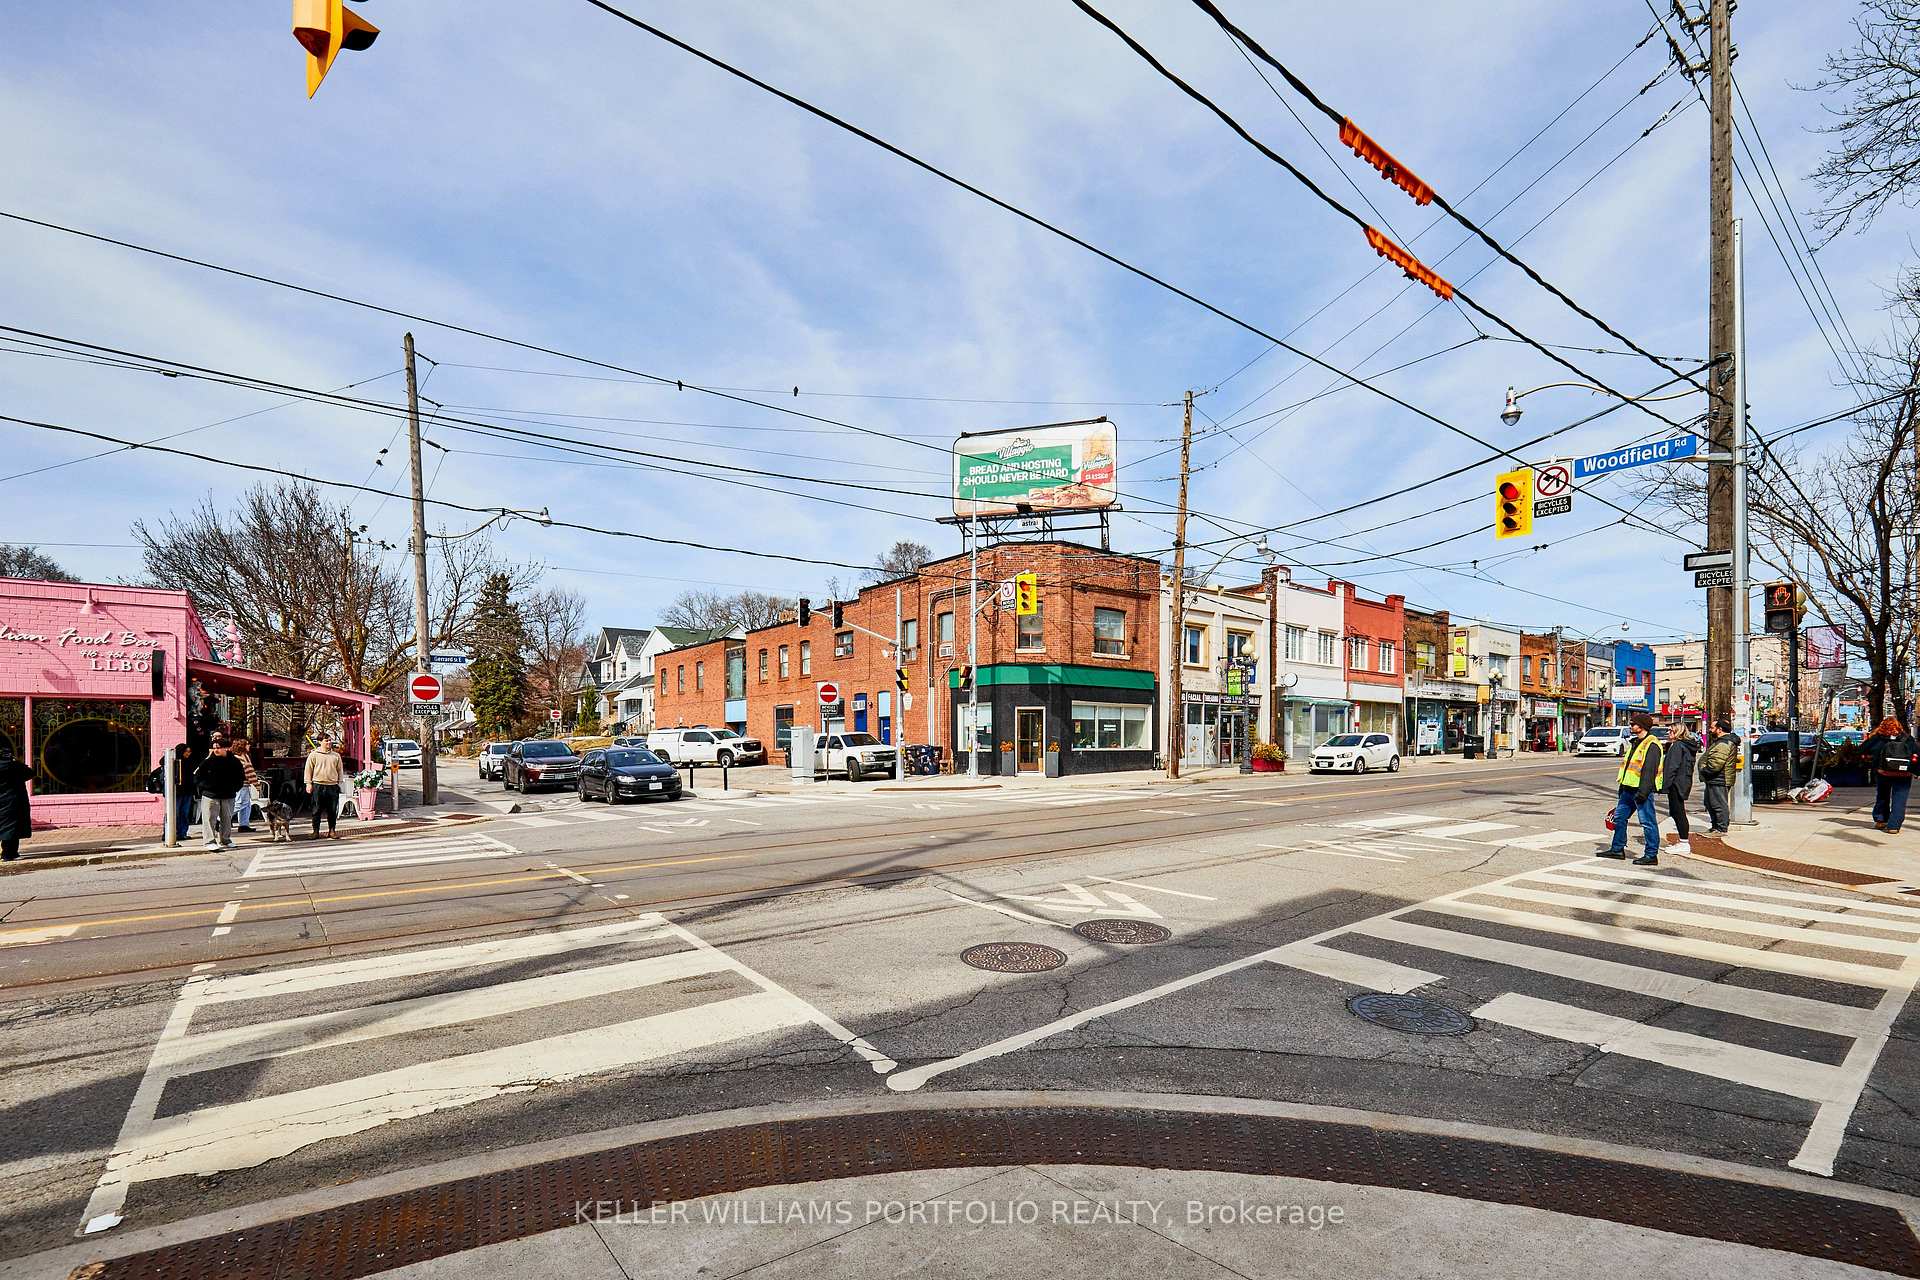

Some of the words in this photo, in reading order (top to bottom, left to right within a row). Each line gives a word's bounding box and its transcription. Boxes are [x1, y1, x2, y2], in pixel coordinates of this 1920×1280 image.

[1583, 442, 1669, 472] Woodfield
[1675, 438, 1687, 447] Rd
[970, 464, 999, 475] BREAD
[1001, 462, 1020, 472] AND
[1022, 458, 1061, 471] HOSTING
[963, 475, 998, 486] SHOULD
[999, 472, 1028, 482] NEVER
[1030, 470, 1041, 480] BE
[1043, 468, 1068, 480] HARD
[1536, 505, 1569, 516] EXCEPTED
[1537, 498, 1568, 509] BICYCLES
[57, 627, 112, 647] Food
[120, 631, 160, 648] Bar
[92, 659, 149, 673] LLBO
